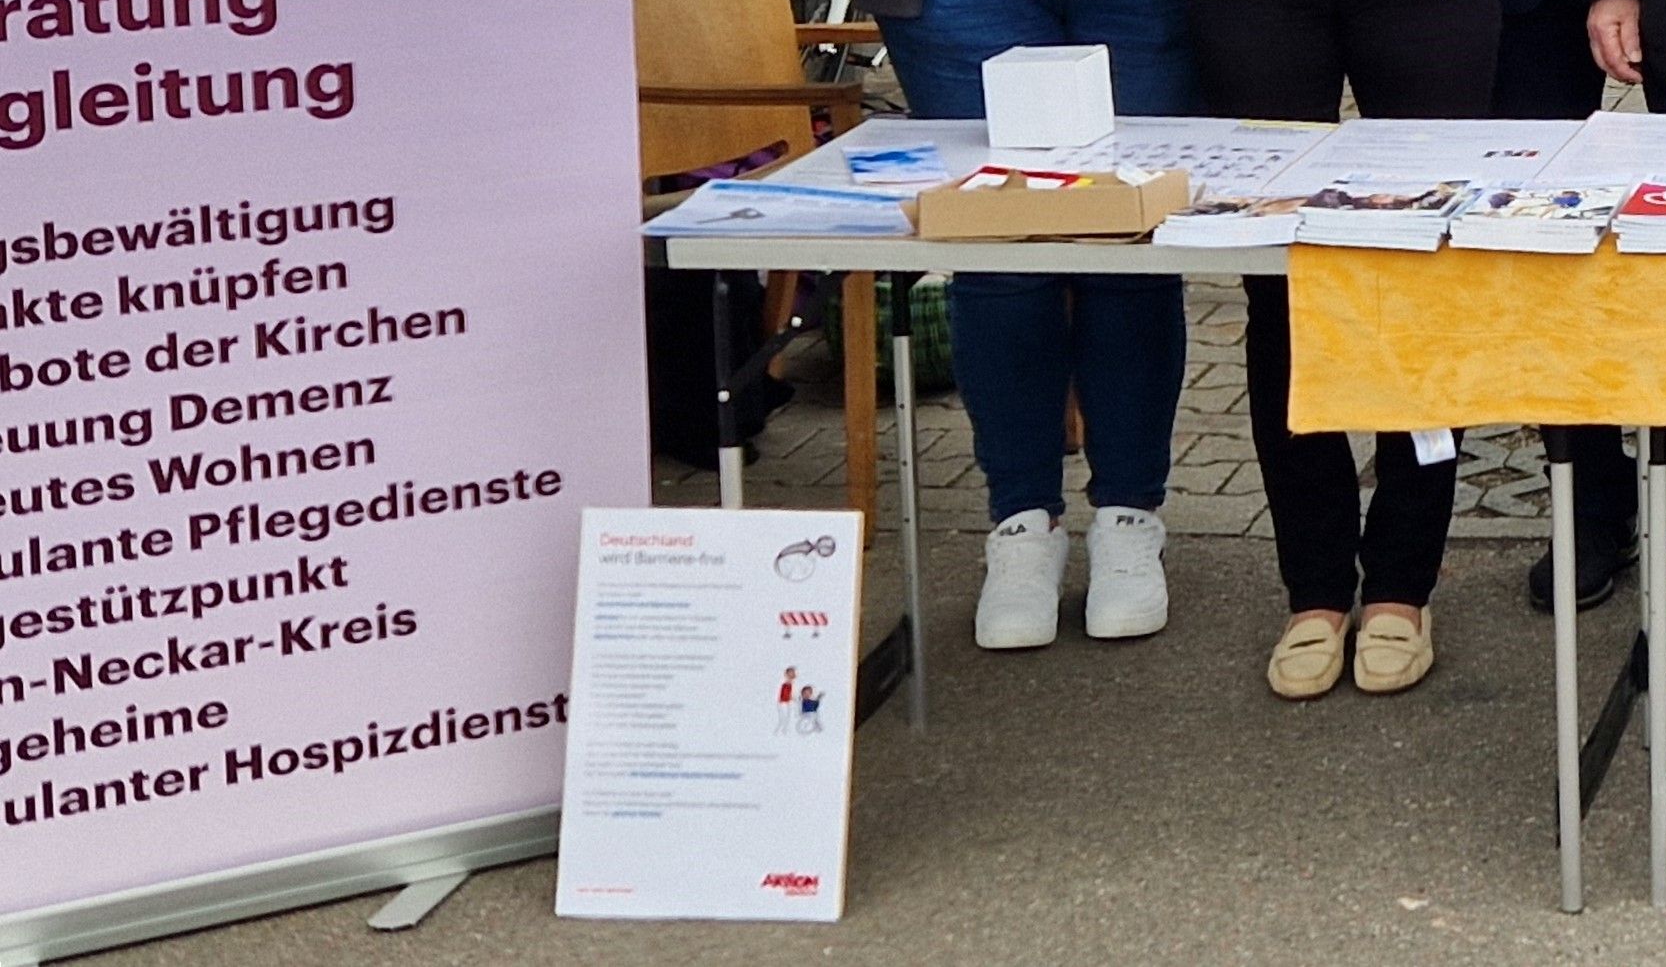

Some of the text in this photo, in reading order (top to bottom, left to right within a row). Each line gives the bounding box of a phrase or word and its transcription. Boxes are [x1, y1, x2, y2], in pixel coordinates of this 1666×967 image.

[0, 62, 357, 151] gleitung
[0, 195, 397, 275] sbewältigung
[0, 258, 349, 330] kte knüpfen
[0, 305, 468, 393] bote der Kirchen
[0, 374, 394, 454] uung Demenz
[0, 436, 377, 517] utes Wohnen
[0, 466, 563, 581] ulante Pflegedienste
[0, 554, 351, 650] estützpunkt
[0, 601, 419, 705] n-Neckar-Kreis
[4, 759, 209, 826] ulanter
[225, 692, 570, 787] Hospizdienst
